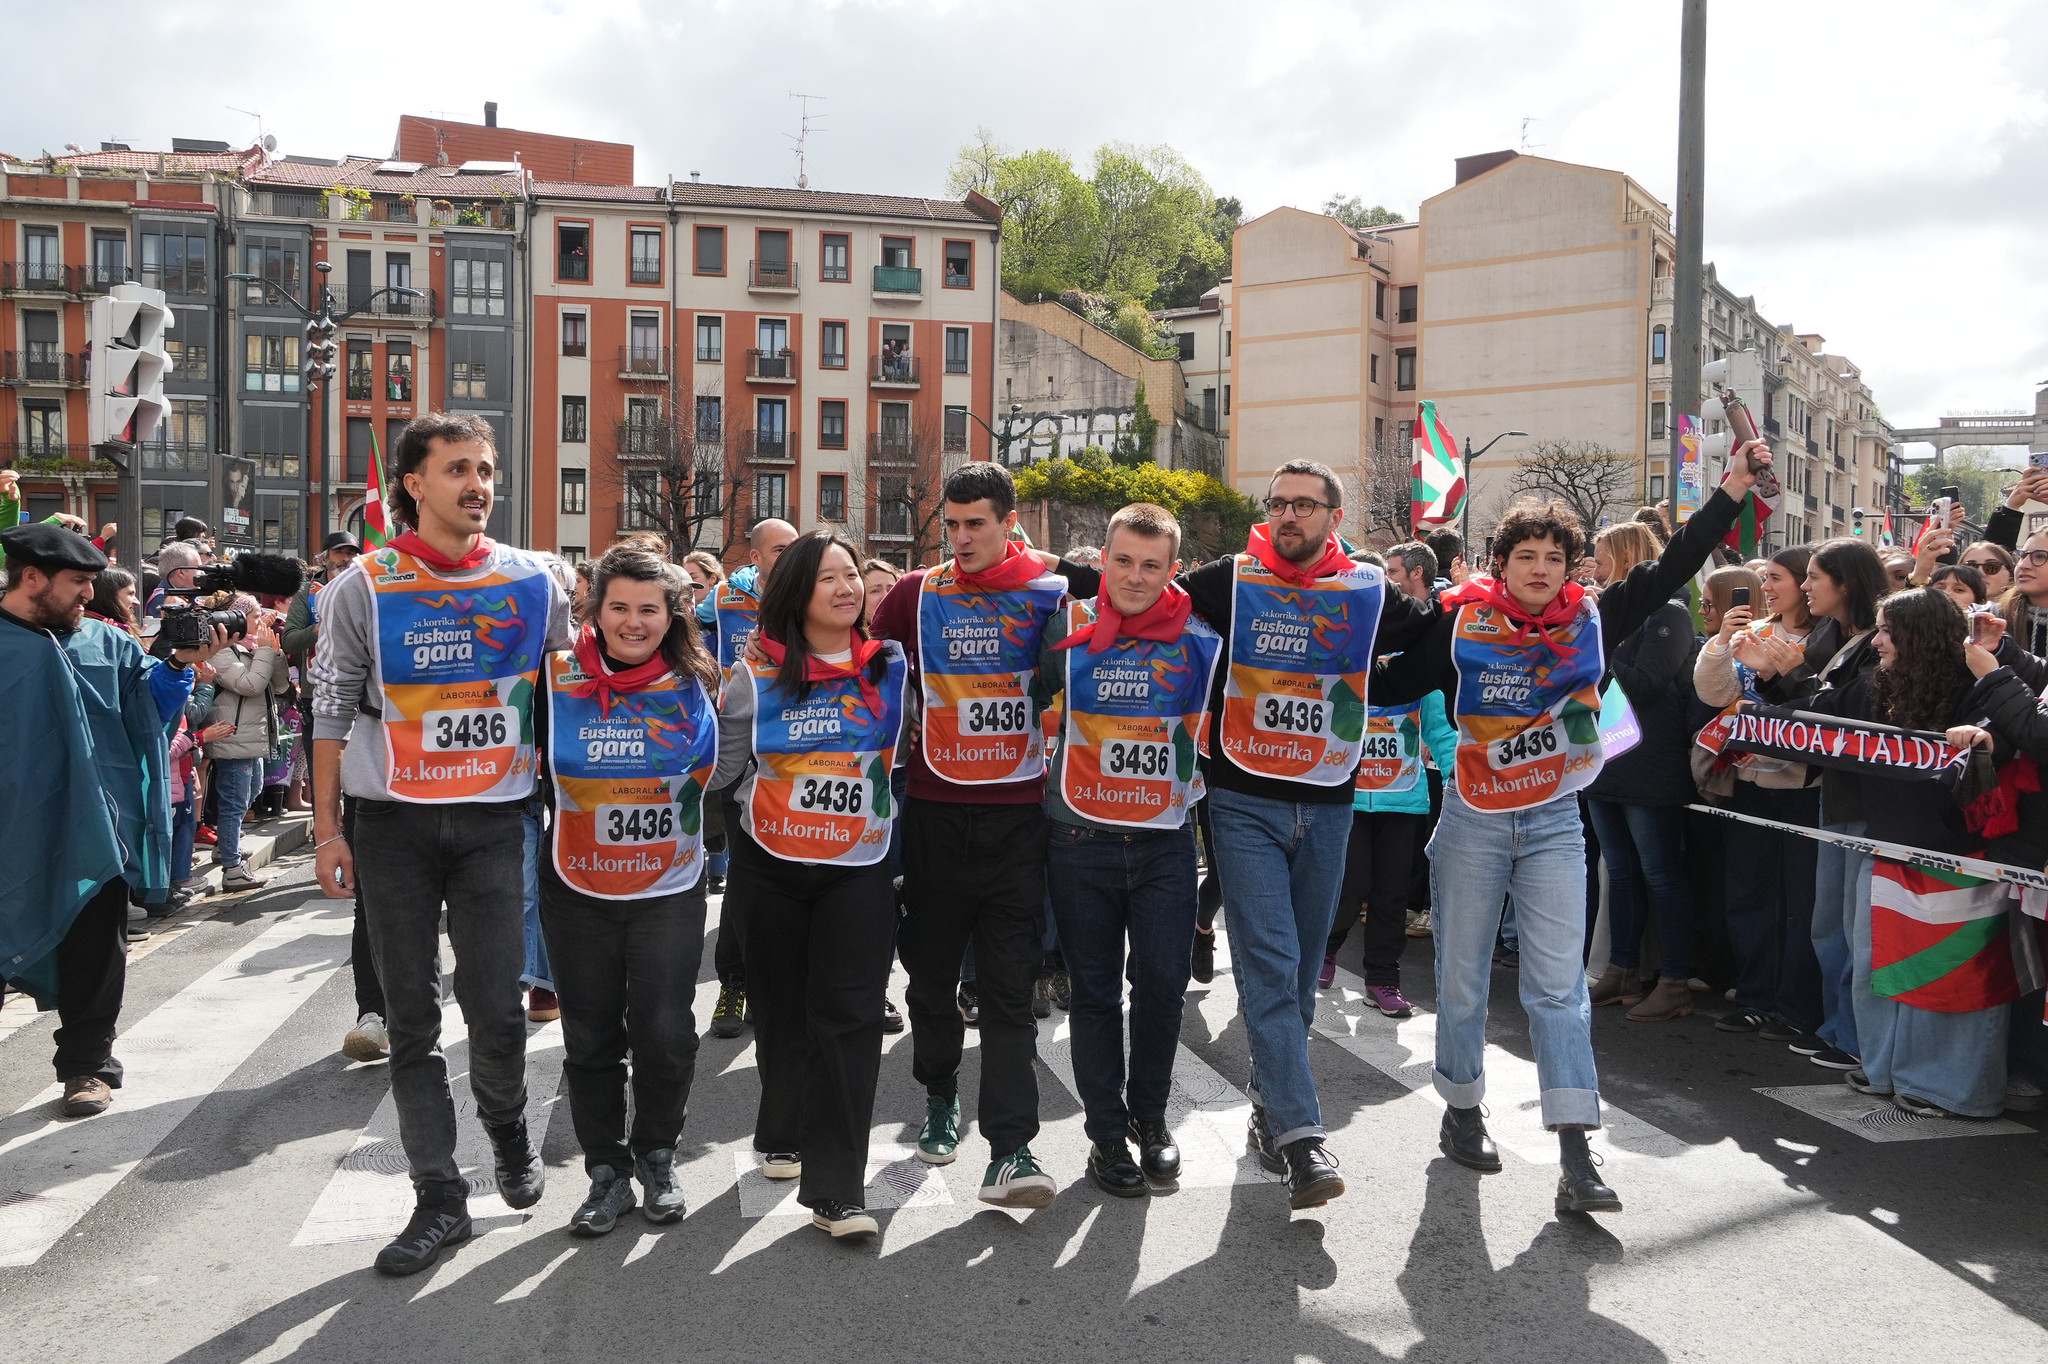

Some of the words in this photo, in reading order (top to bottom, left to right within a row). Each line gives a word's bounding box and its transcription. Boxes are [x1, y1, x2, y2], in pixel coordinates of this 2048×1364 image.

[1350, 571, 1374, 580] eitb
[413, 616, 455, 628] 24.korrika
[948, 616, 984, 624] 24.korrika
[1260, 610, 1297, 620] 24.korrika
[404, 628, 472, 646] Euskara
[942, 625, 998, 638] Euskara
[1250, 618, 1310, 636] Euskara
[948, 639, 1000, 660] gara
[1254, 634, 1308, 654] gara
[413, 642, 473, 670] gara
[1102, 658, 1136, 666] 24.korrika
[1092, 666, 1149, 681] Euskara
[1272, 678, 1306, 688] LABORAL
[1478, 671, 1531, 686] Euskara
[440, 690, 482, 700] LABORAL
[1096, 681, 1150, 702] gara
[1482, 686, 1530, 704] gara
[781, 706, 838, 720] Euskara
[969, 701, 1026, 732] 3436
[1264, 698, 1324, 734] 3436
[436, 712, 506, 748] 3436
[579, 726, 644, 740] Euskara
[788, 720, 841, 740] gara
[1118, 724, 1152, 732] LABORAL
[587, 740, 645, 762] gara
[933, 742, 1018, 762] 24.korrika
[1026, 742, 1042, 759] aek
[1226, 736, 1312, 762] 24.korrika
[1323, 746, 1350, 766] aek
[1498, 725, 1556, 765] 3436
[1854, 729, 1971, 781] TALDEA
[392, 758, 498, 782] 24.korrika
[510, 754, 532, 776] aek
[1110, 743, 1169, 776] 3436
[1401, 765, 1416, 776] aek
[1470, 767, 1558, 797] 24.korrika
[1564, 751, 1594, 776] aek
[800, 779, 862, 814] 3436
[1074, 782, 1162, 806] 24.korrika
[1170, 788, 1186, 808] aek
[608, 808, 672, 842] 3436
[760, 817, 850, 843] 24.korrika
[861, 828, 886, 844] aek
[567, 852, 662, 873] 24.korrika
[673, 841, 698, 868] aek
